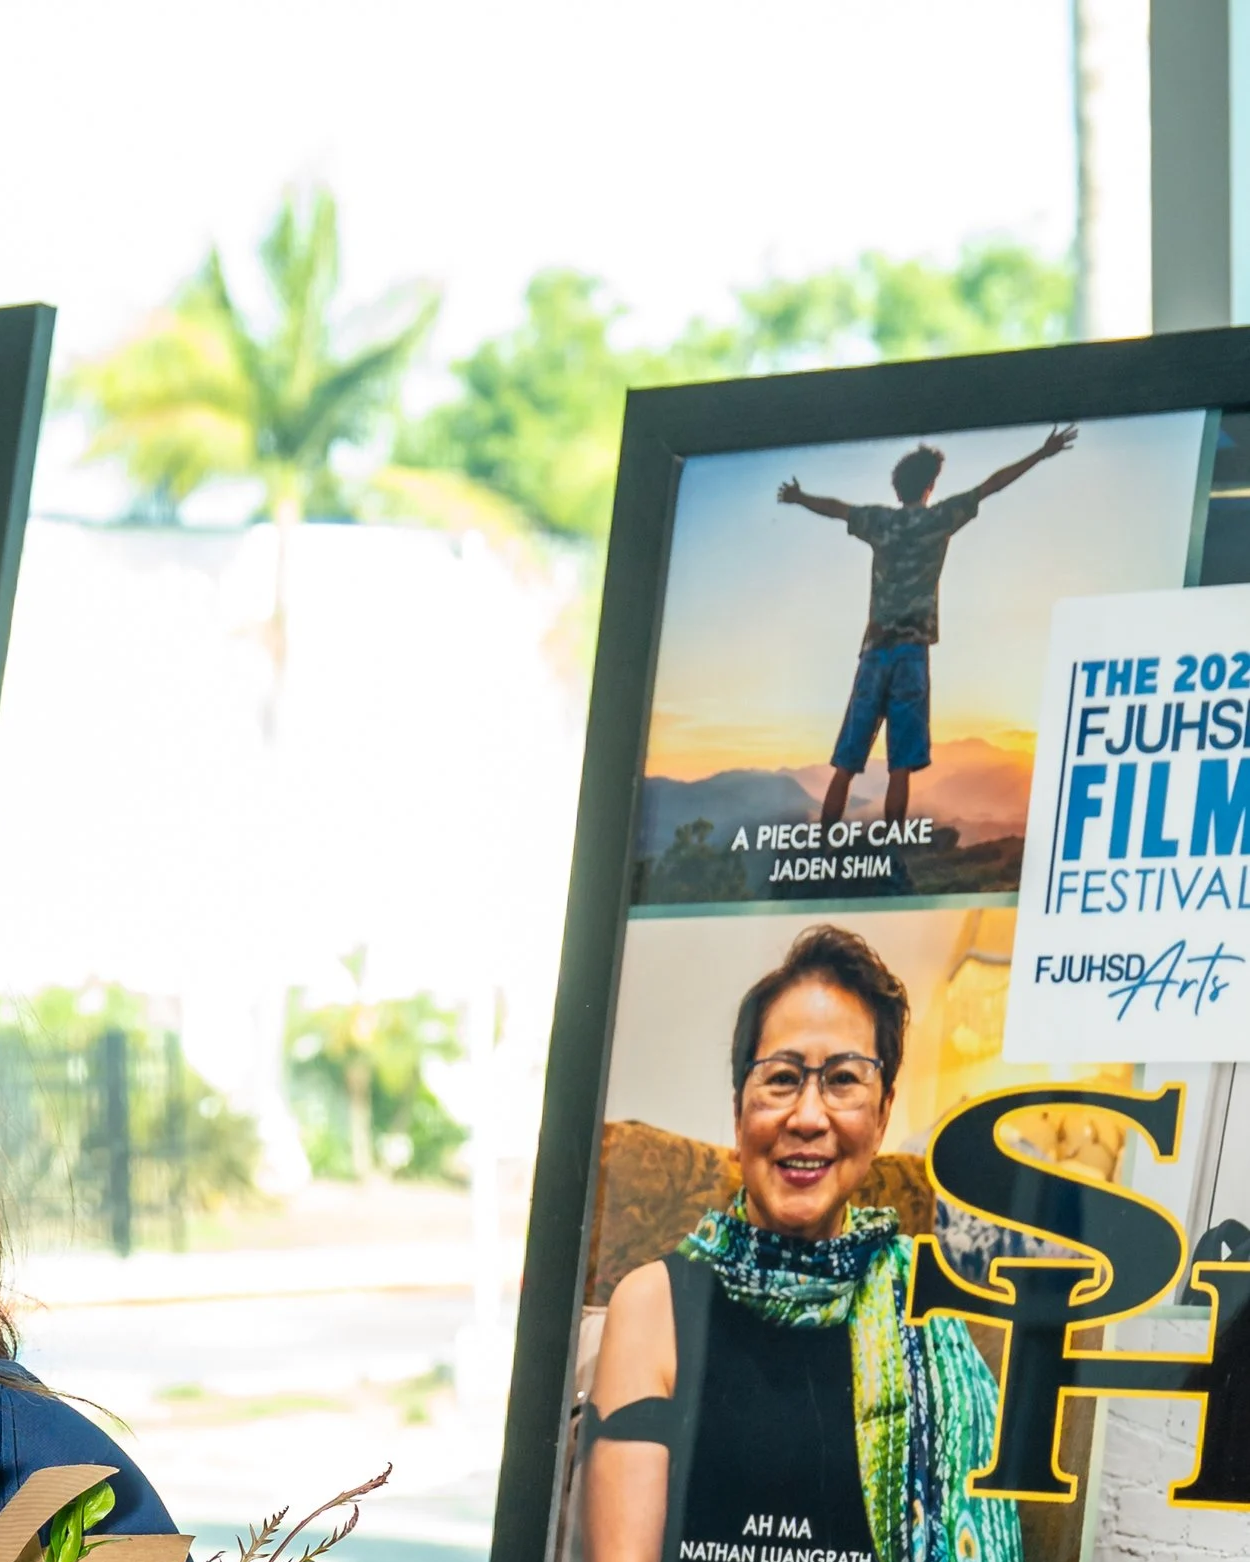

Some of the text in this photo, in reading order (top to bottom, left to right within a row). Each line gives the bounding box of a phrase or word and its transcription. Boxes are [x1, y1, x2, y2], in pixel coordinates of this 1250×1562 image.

[1081, 656, 1160, 698] THE
[731, 818, 933, 851] A PIECE OF CAKE
[769, 855, 892, 882] JADEN SHIM
[1056, 865, 1250, 914] FESTIVAL
[742, 1514, 812, 1540] AH MA
